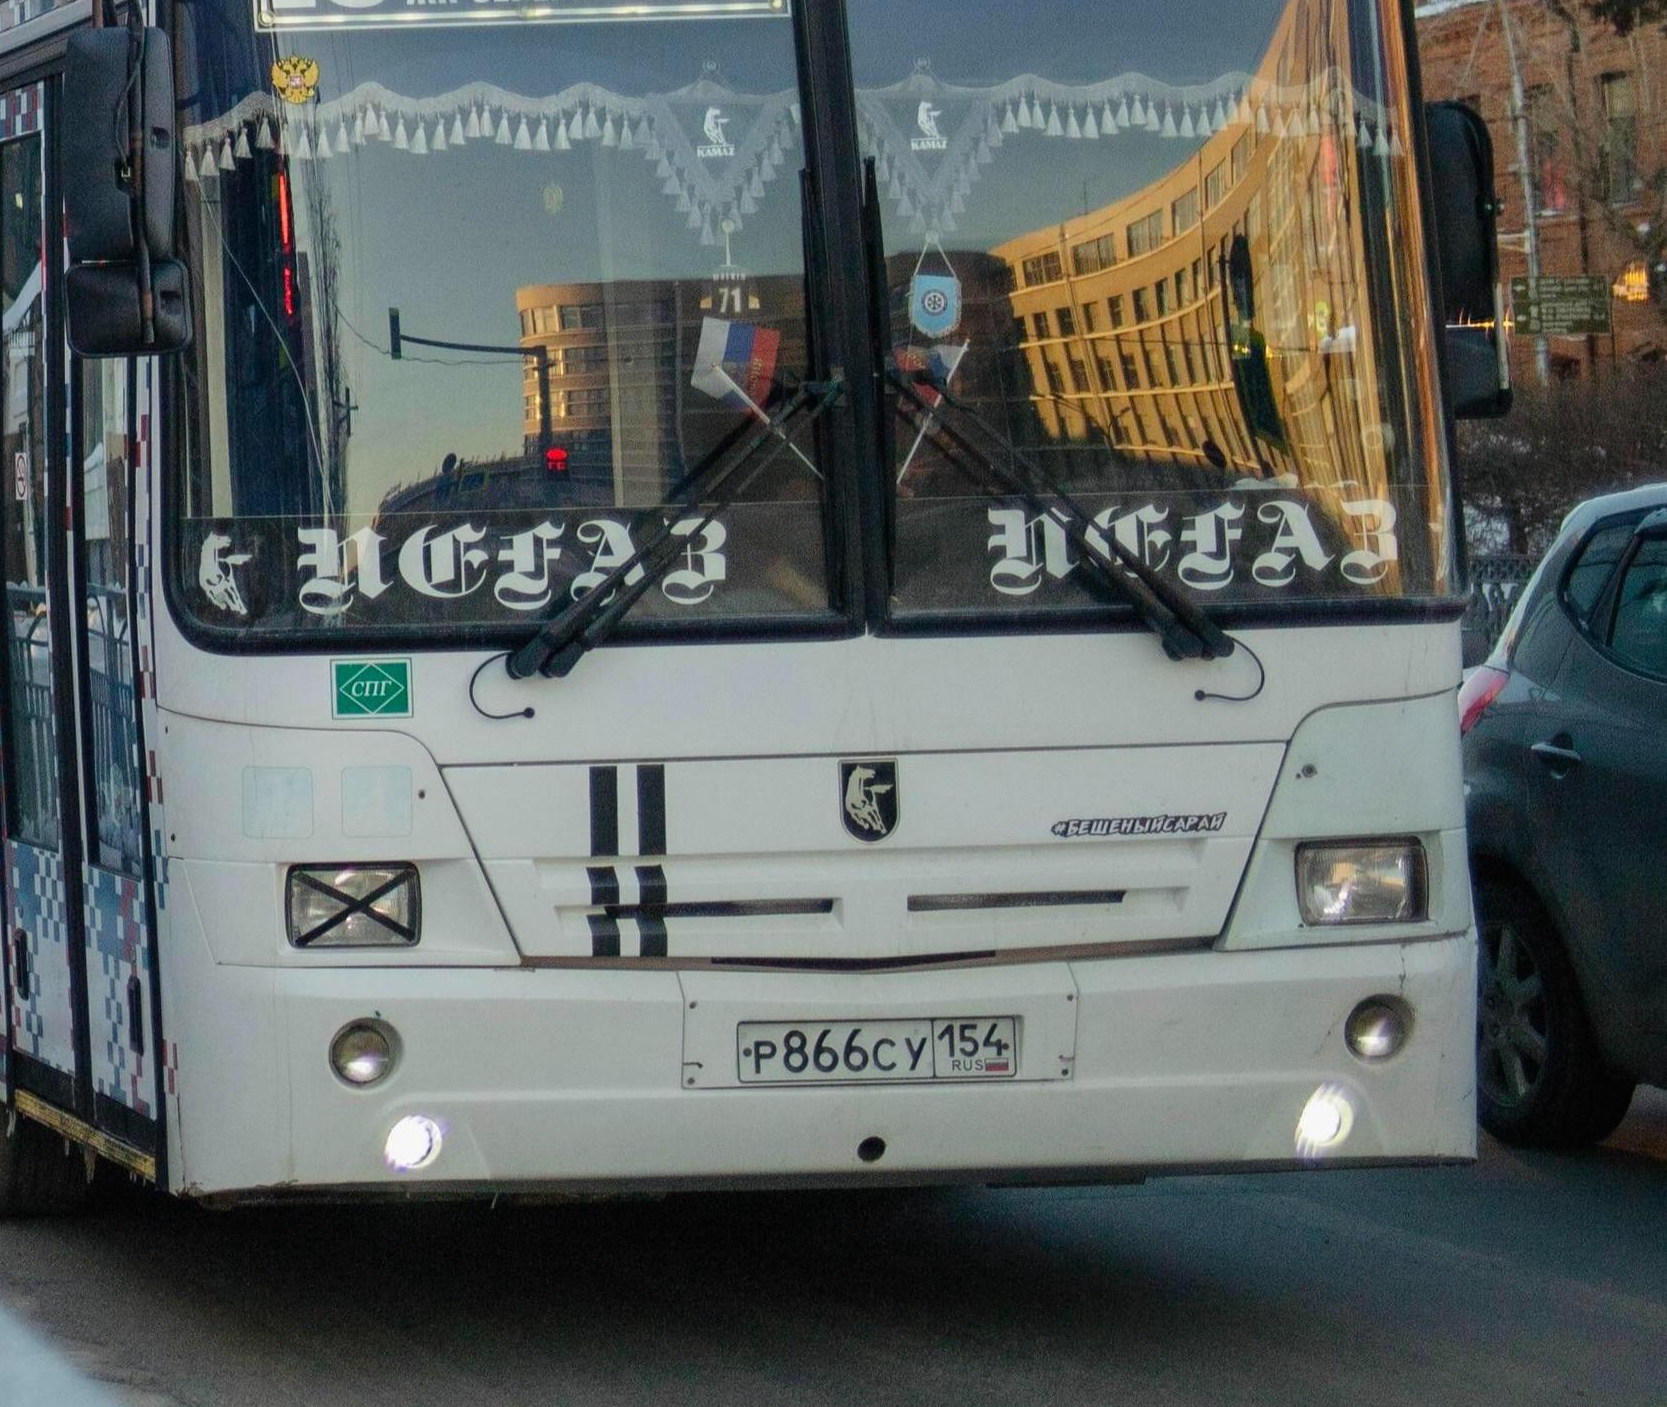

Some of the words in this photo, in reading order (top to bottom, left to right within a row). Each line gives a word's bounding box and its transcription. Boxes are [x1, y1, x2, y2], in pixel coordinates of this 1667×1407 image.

[719, 288, 742, 313] 71
[351, 680, 392, 697] СПГ
[1052, 811, 1227, 837] #БЕШЕНЫЙСАРАЙ
[753, 1028, 928, 1074] Р866СУ
[936, 1023, 1005, 1058] 154
[951, 1059, 984, 1072] RUS
